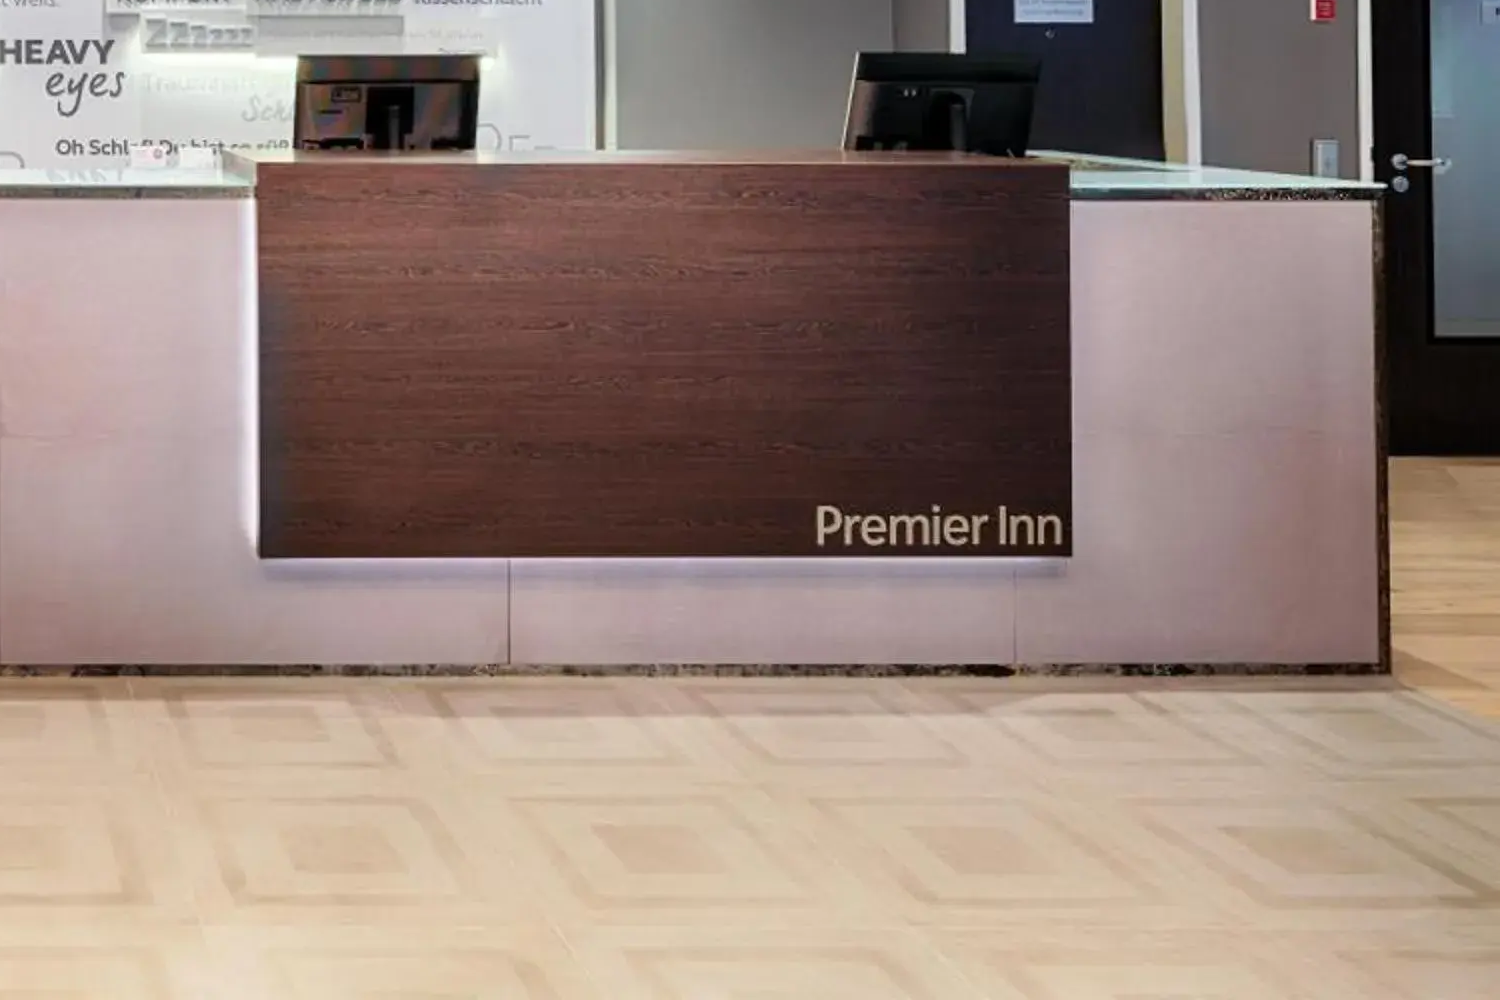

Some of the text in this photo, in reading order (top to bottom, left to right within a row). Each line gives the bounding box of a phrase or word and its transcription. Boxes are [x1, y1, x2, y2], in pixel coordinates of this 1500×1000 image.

[46, 71, 125, 117] eyes
[56, 139, 84, 156] Oh
[817, 504, 1062, 546] Premier Inn
